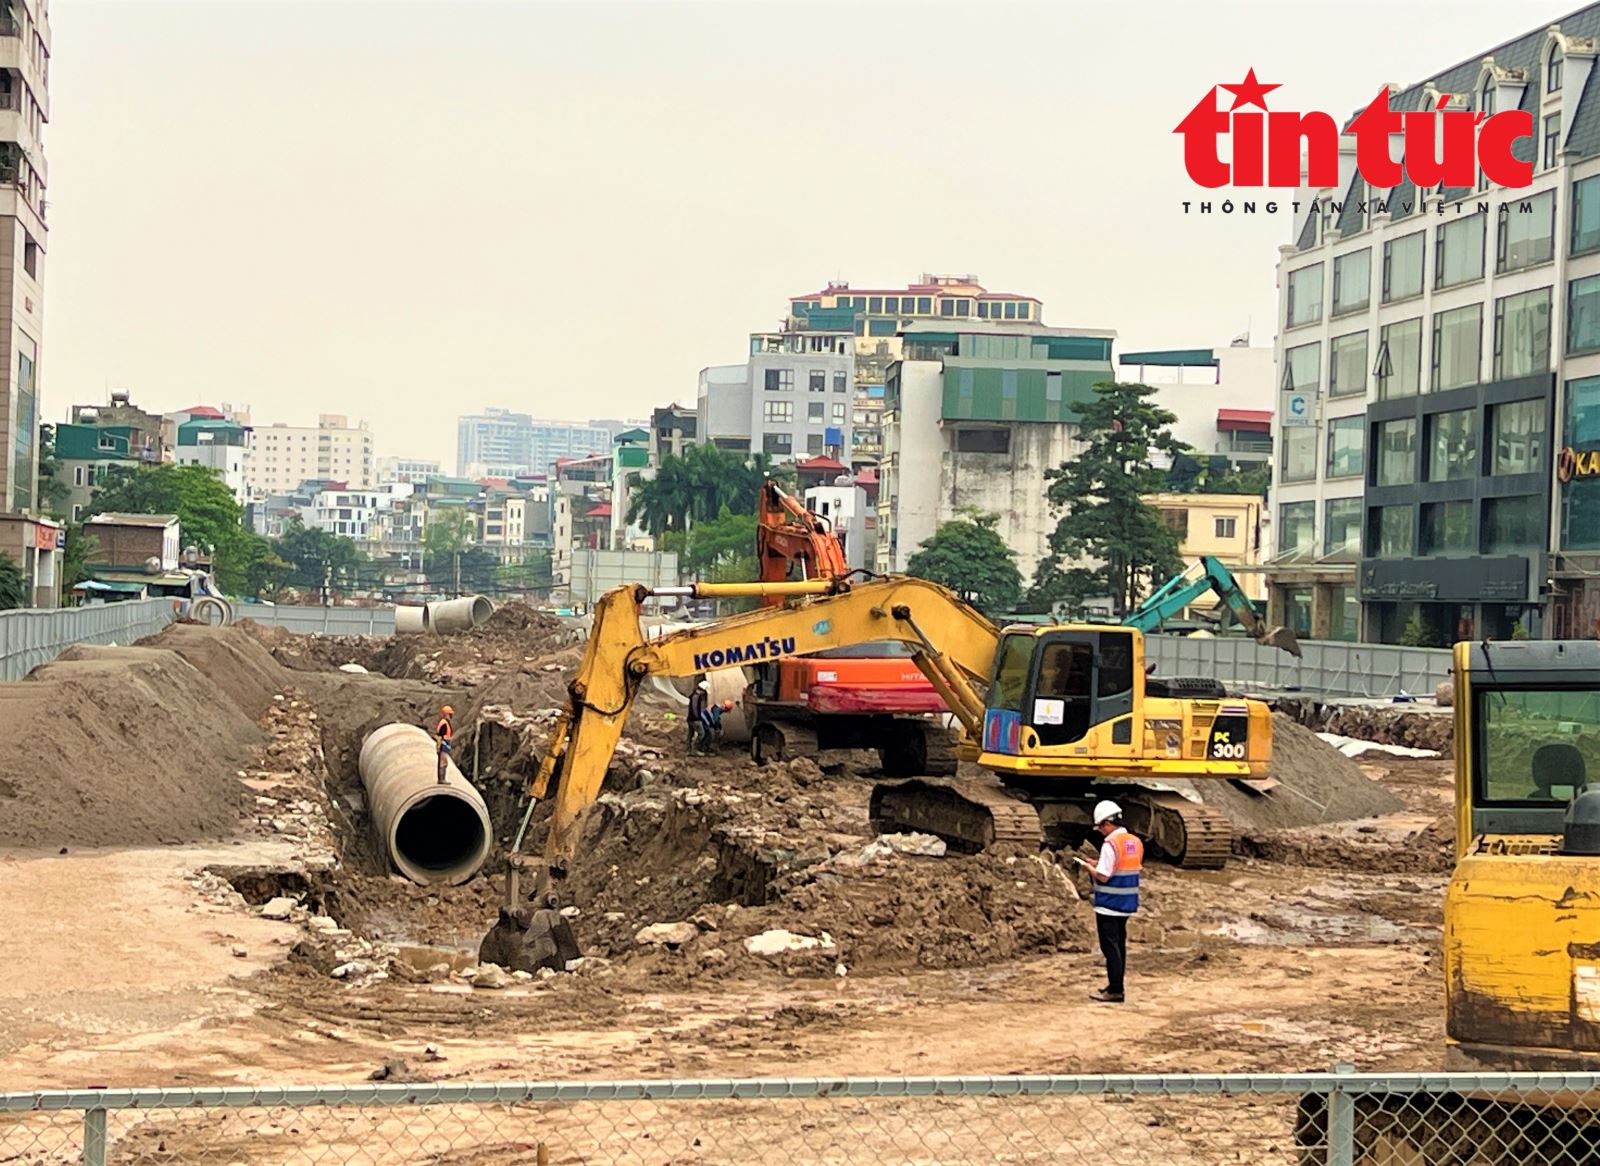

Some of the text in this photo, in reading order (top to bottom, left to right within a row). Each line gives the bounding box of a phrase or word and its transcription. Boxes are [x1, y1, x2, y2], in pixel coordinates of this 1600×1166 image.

[693, 636, 796, 670] KOMATSU
[1213, 731, 1230, 743] PC
[1213, 743, 1245, 759] 300
